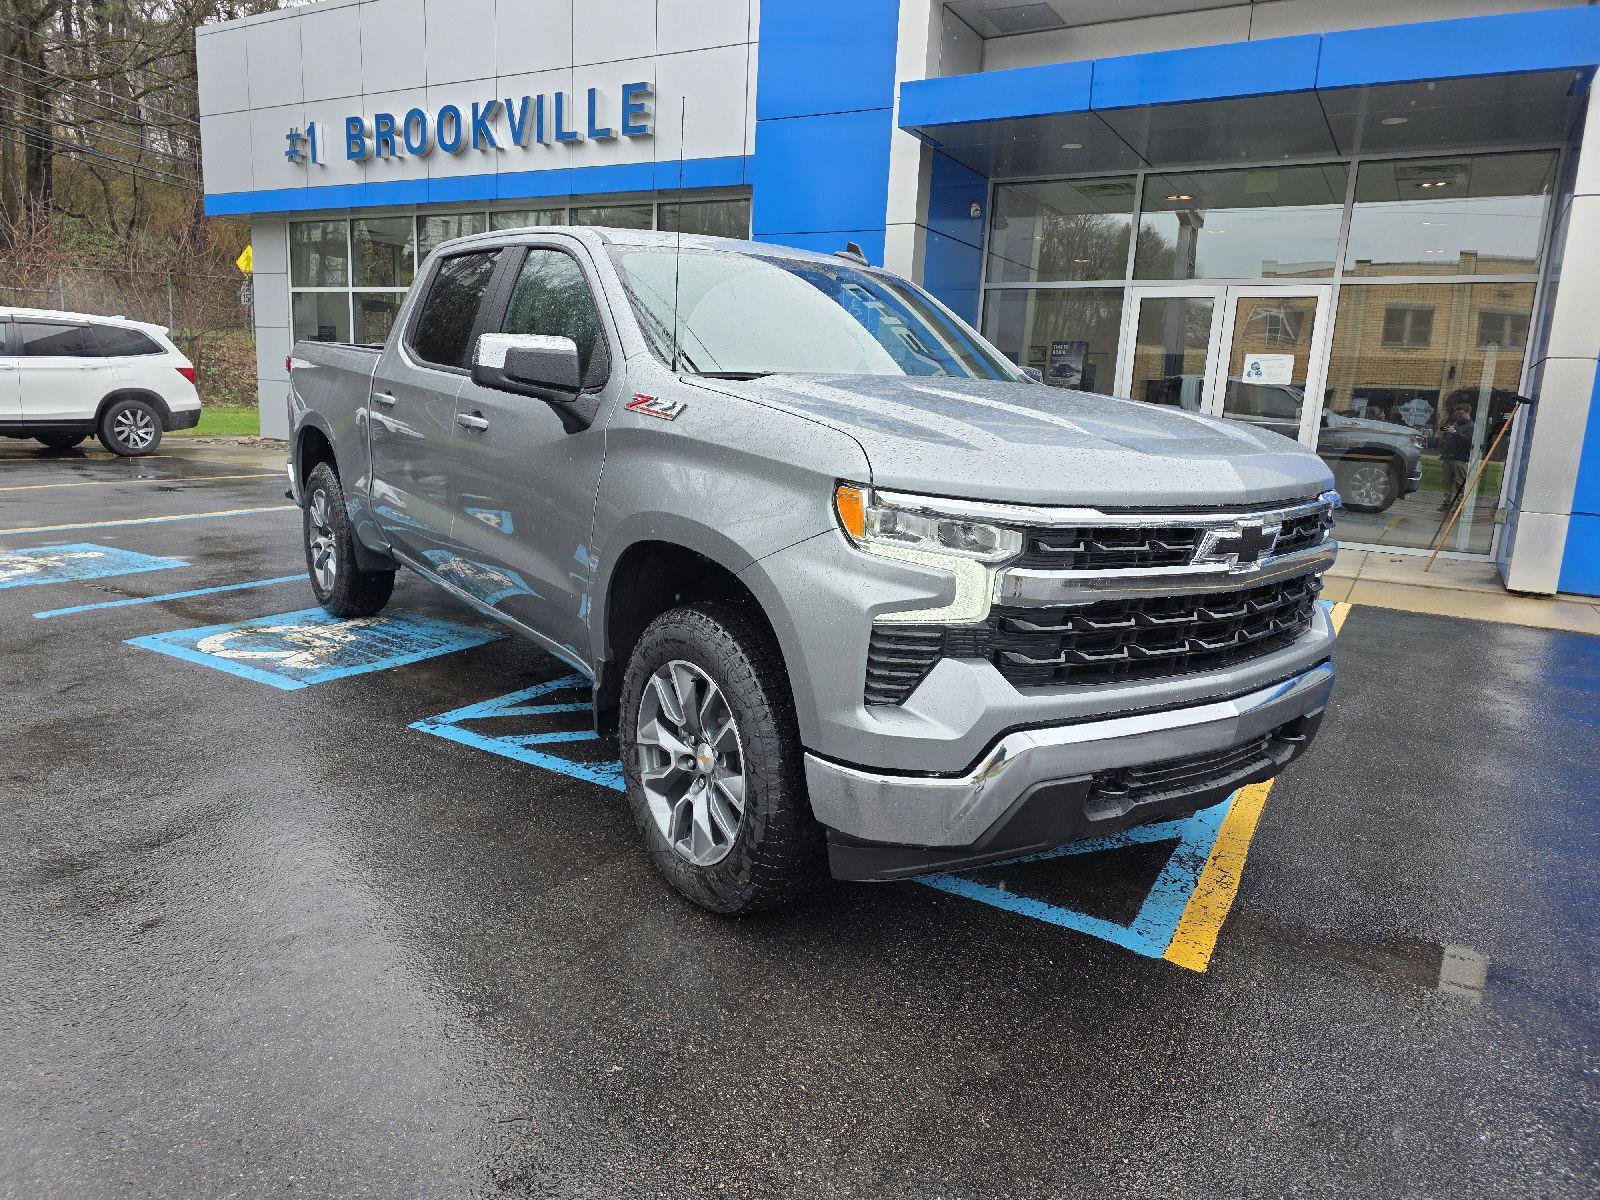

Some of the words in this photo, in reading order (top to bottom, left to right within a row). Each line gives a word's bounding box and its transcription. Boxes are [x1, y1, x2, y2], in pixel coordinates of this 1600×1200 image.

[284, 121, 323, 166] #1
[345, 81, 655, 161] BROOKVILLE
[624, 392, 688, 421] Z71
